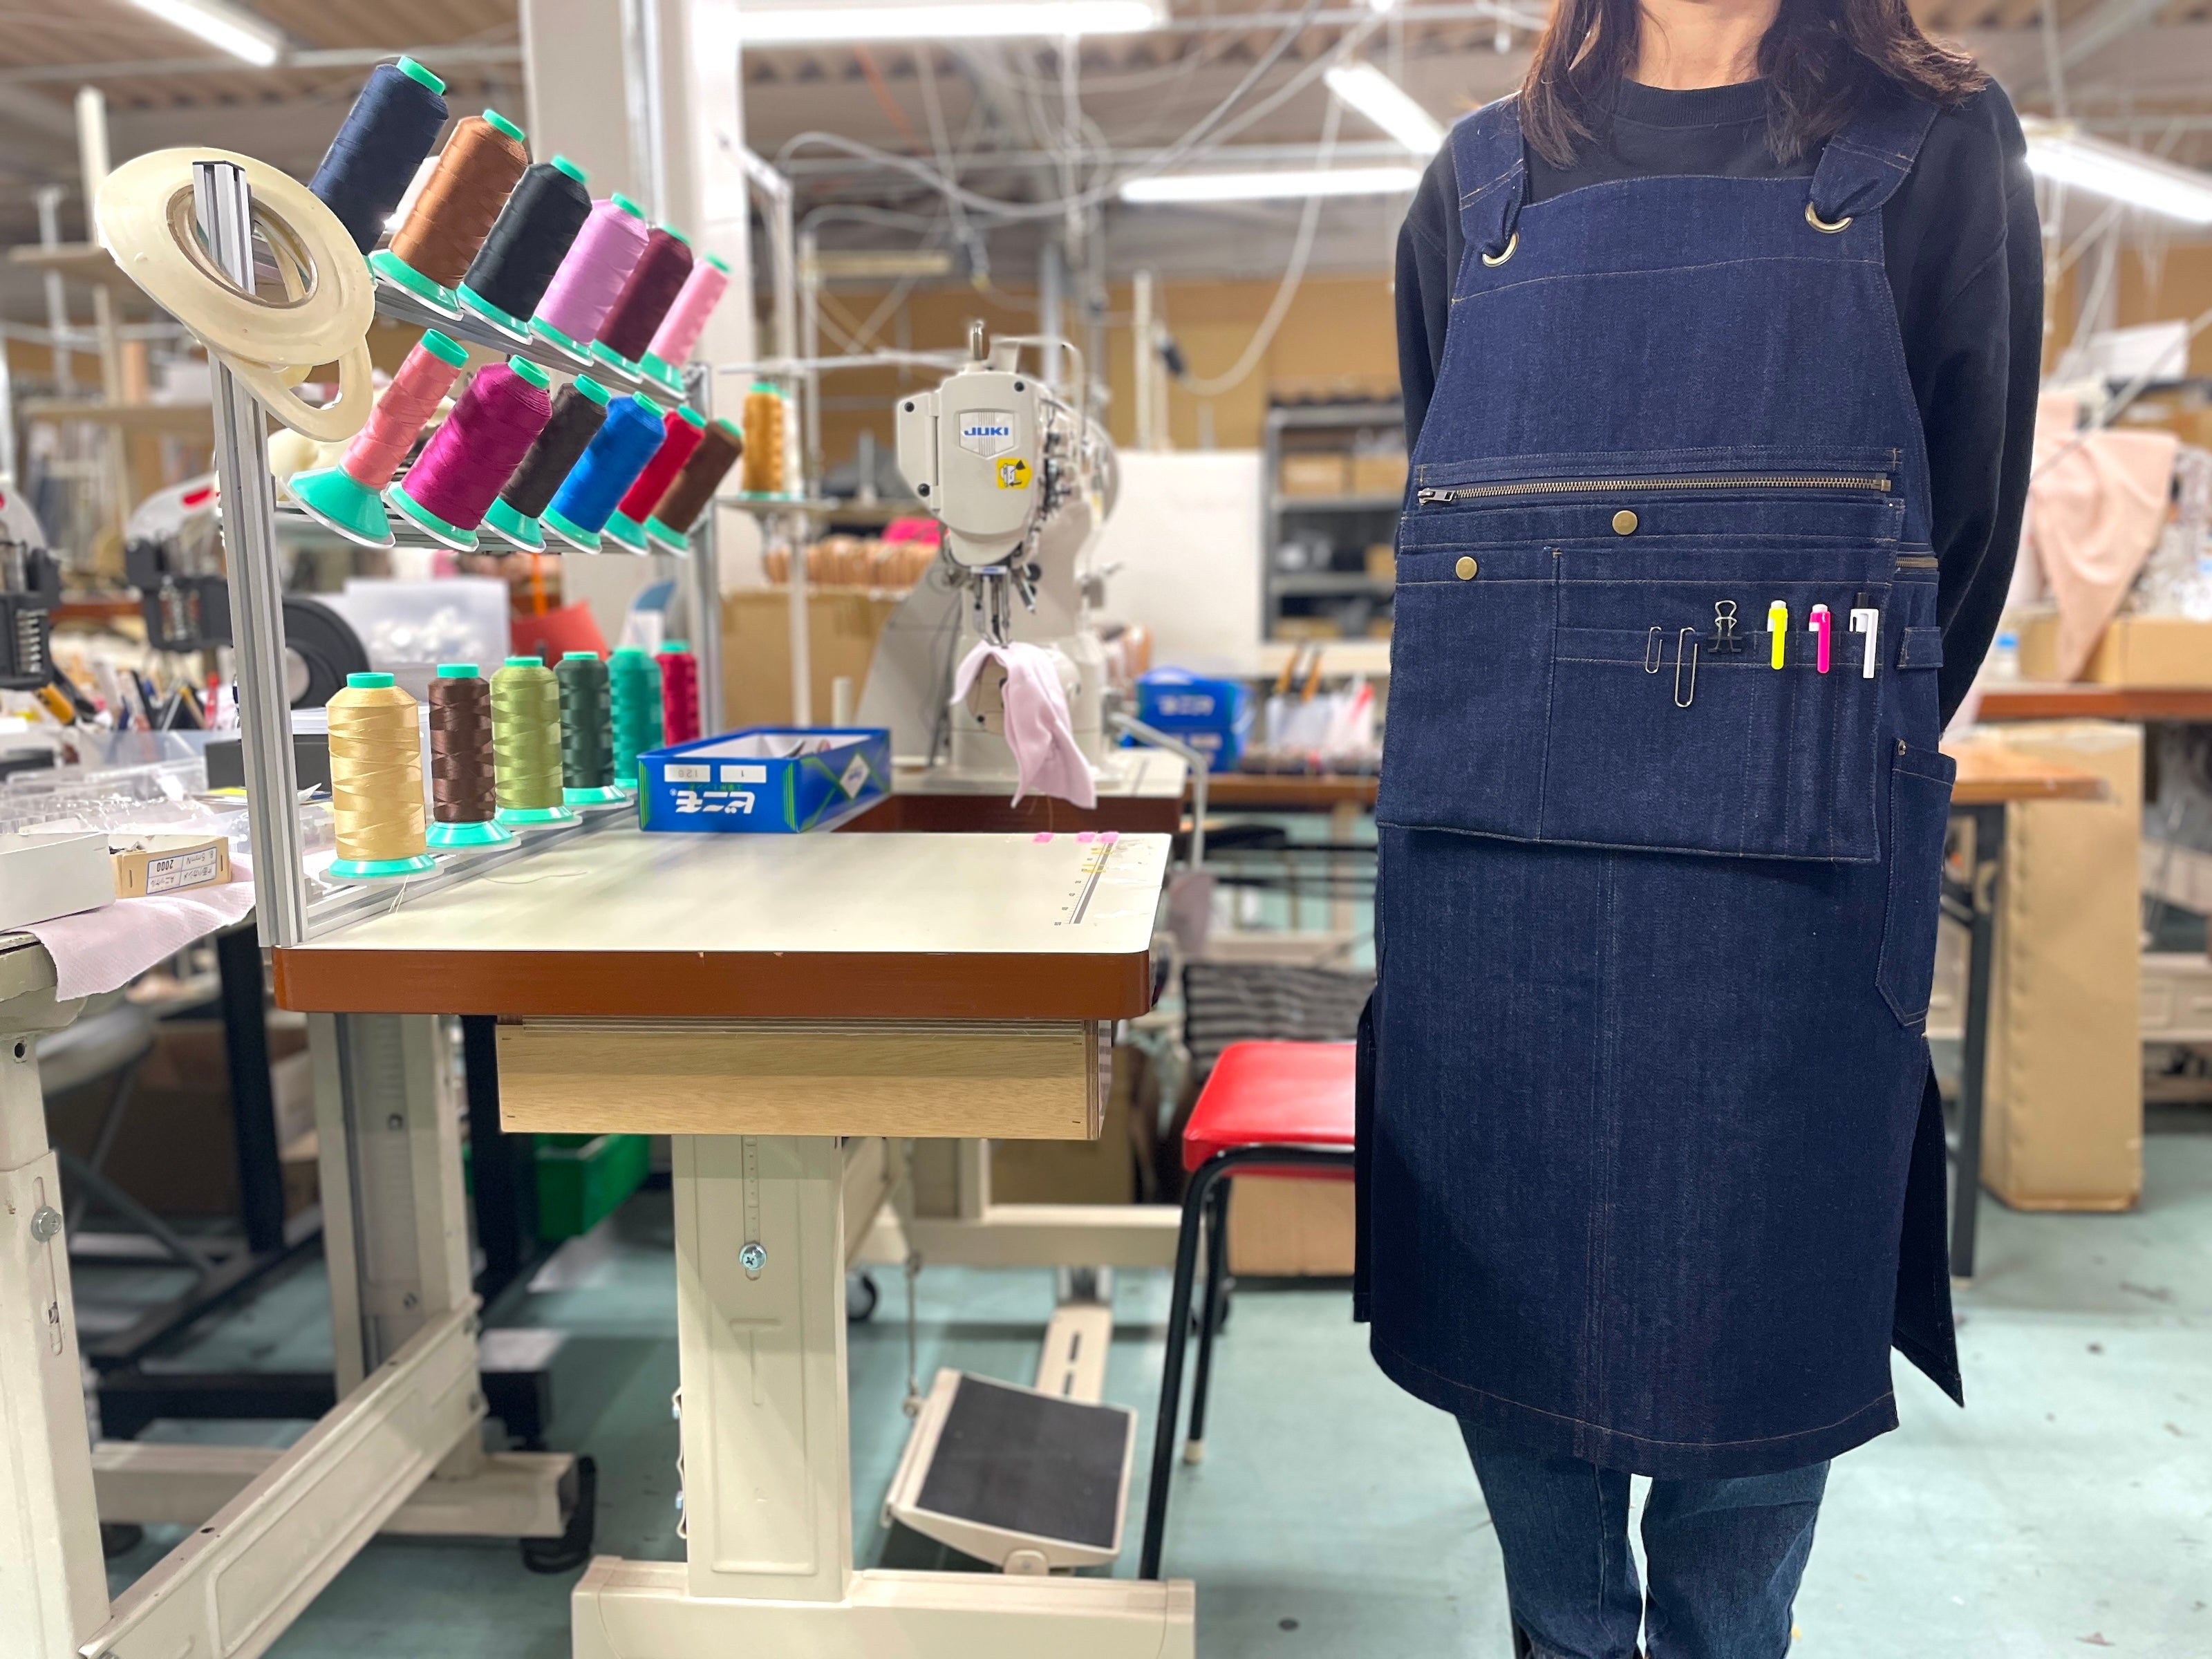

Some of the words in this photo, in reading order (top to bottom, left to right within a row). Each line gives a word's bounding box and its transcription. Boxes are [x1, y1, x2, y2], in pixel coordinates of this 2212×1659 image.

[964, 427, 1009, 436] JUKI
[675, 790, 756, 814] ビニモ
[156, 859, 174, 872] 2000
